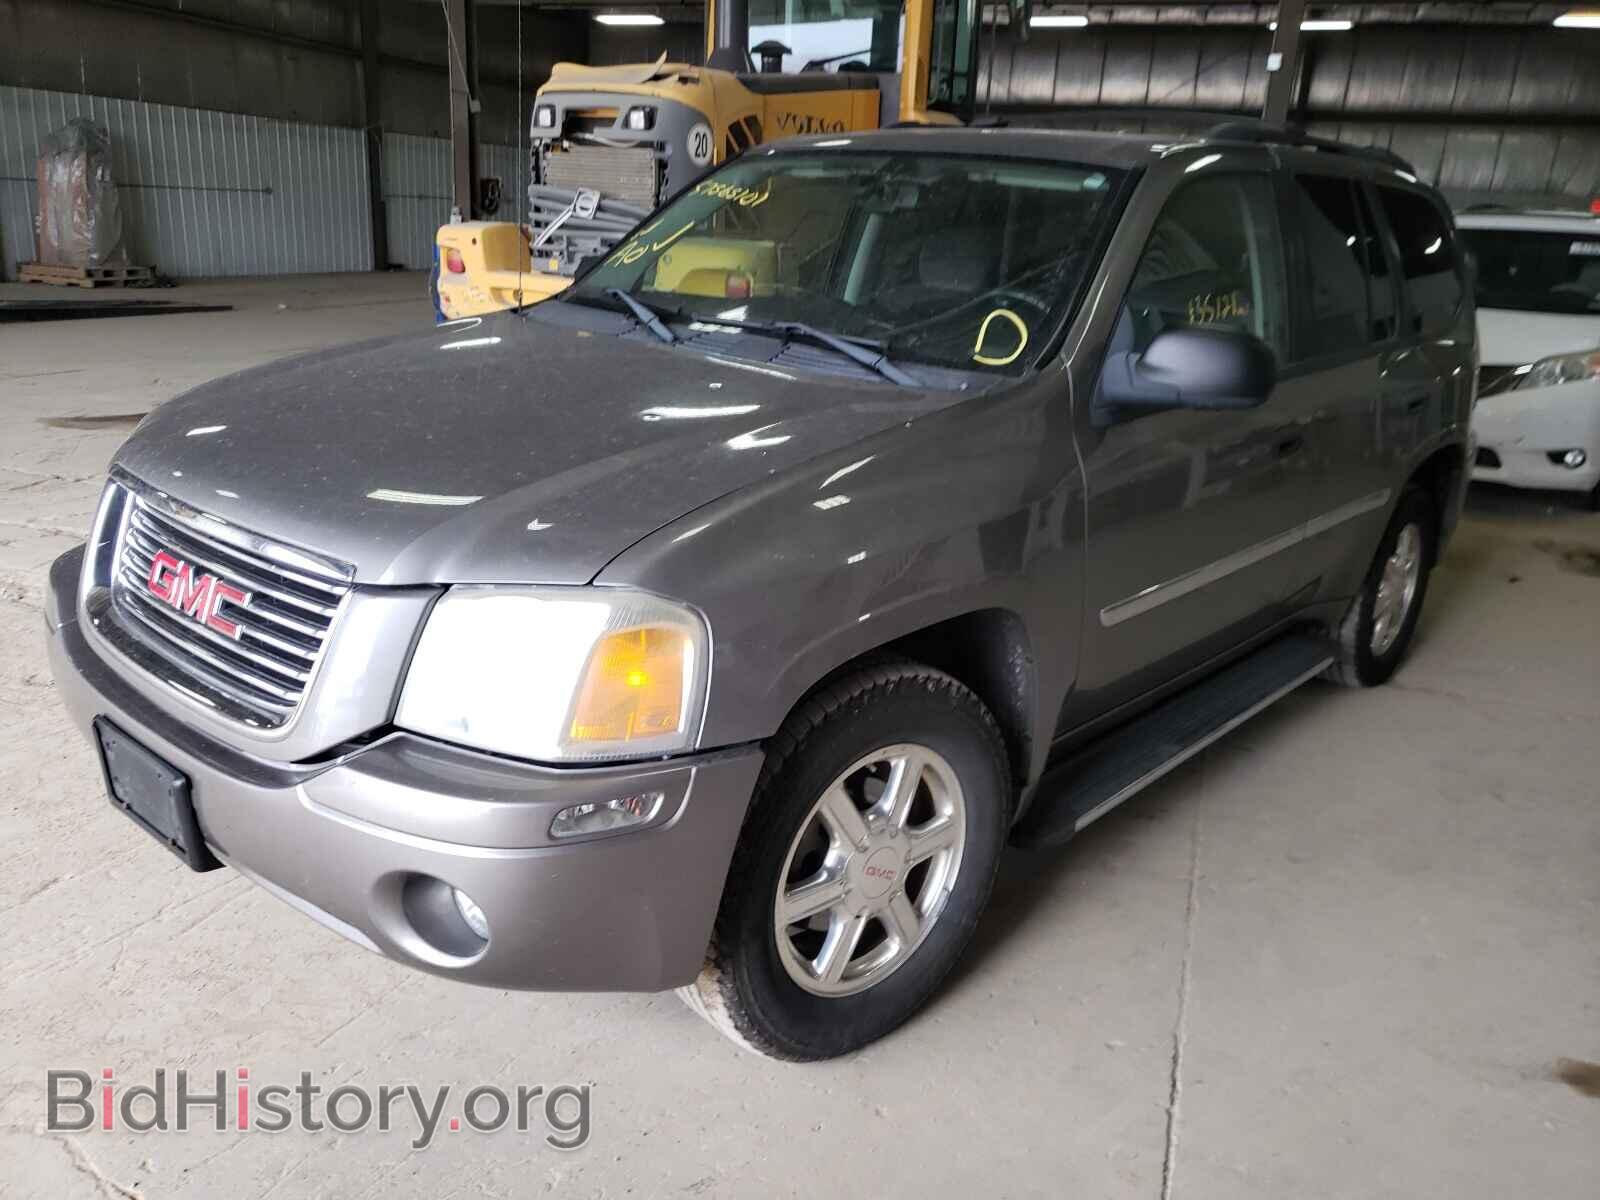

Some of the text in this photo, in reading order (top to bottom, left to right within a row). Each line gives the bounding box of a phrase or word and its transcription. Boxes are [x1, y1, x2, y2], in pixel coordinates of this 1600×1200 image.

[776, 111, 846, 134] VOLVO
[694, 131, 709, 158] 20
[148, 549, 252, 641] GMC
[865, 866, 897, 881] GMC
